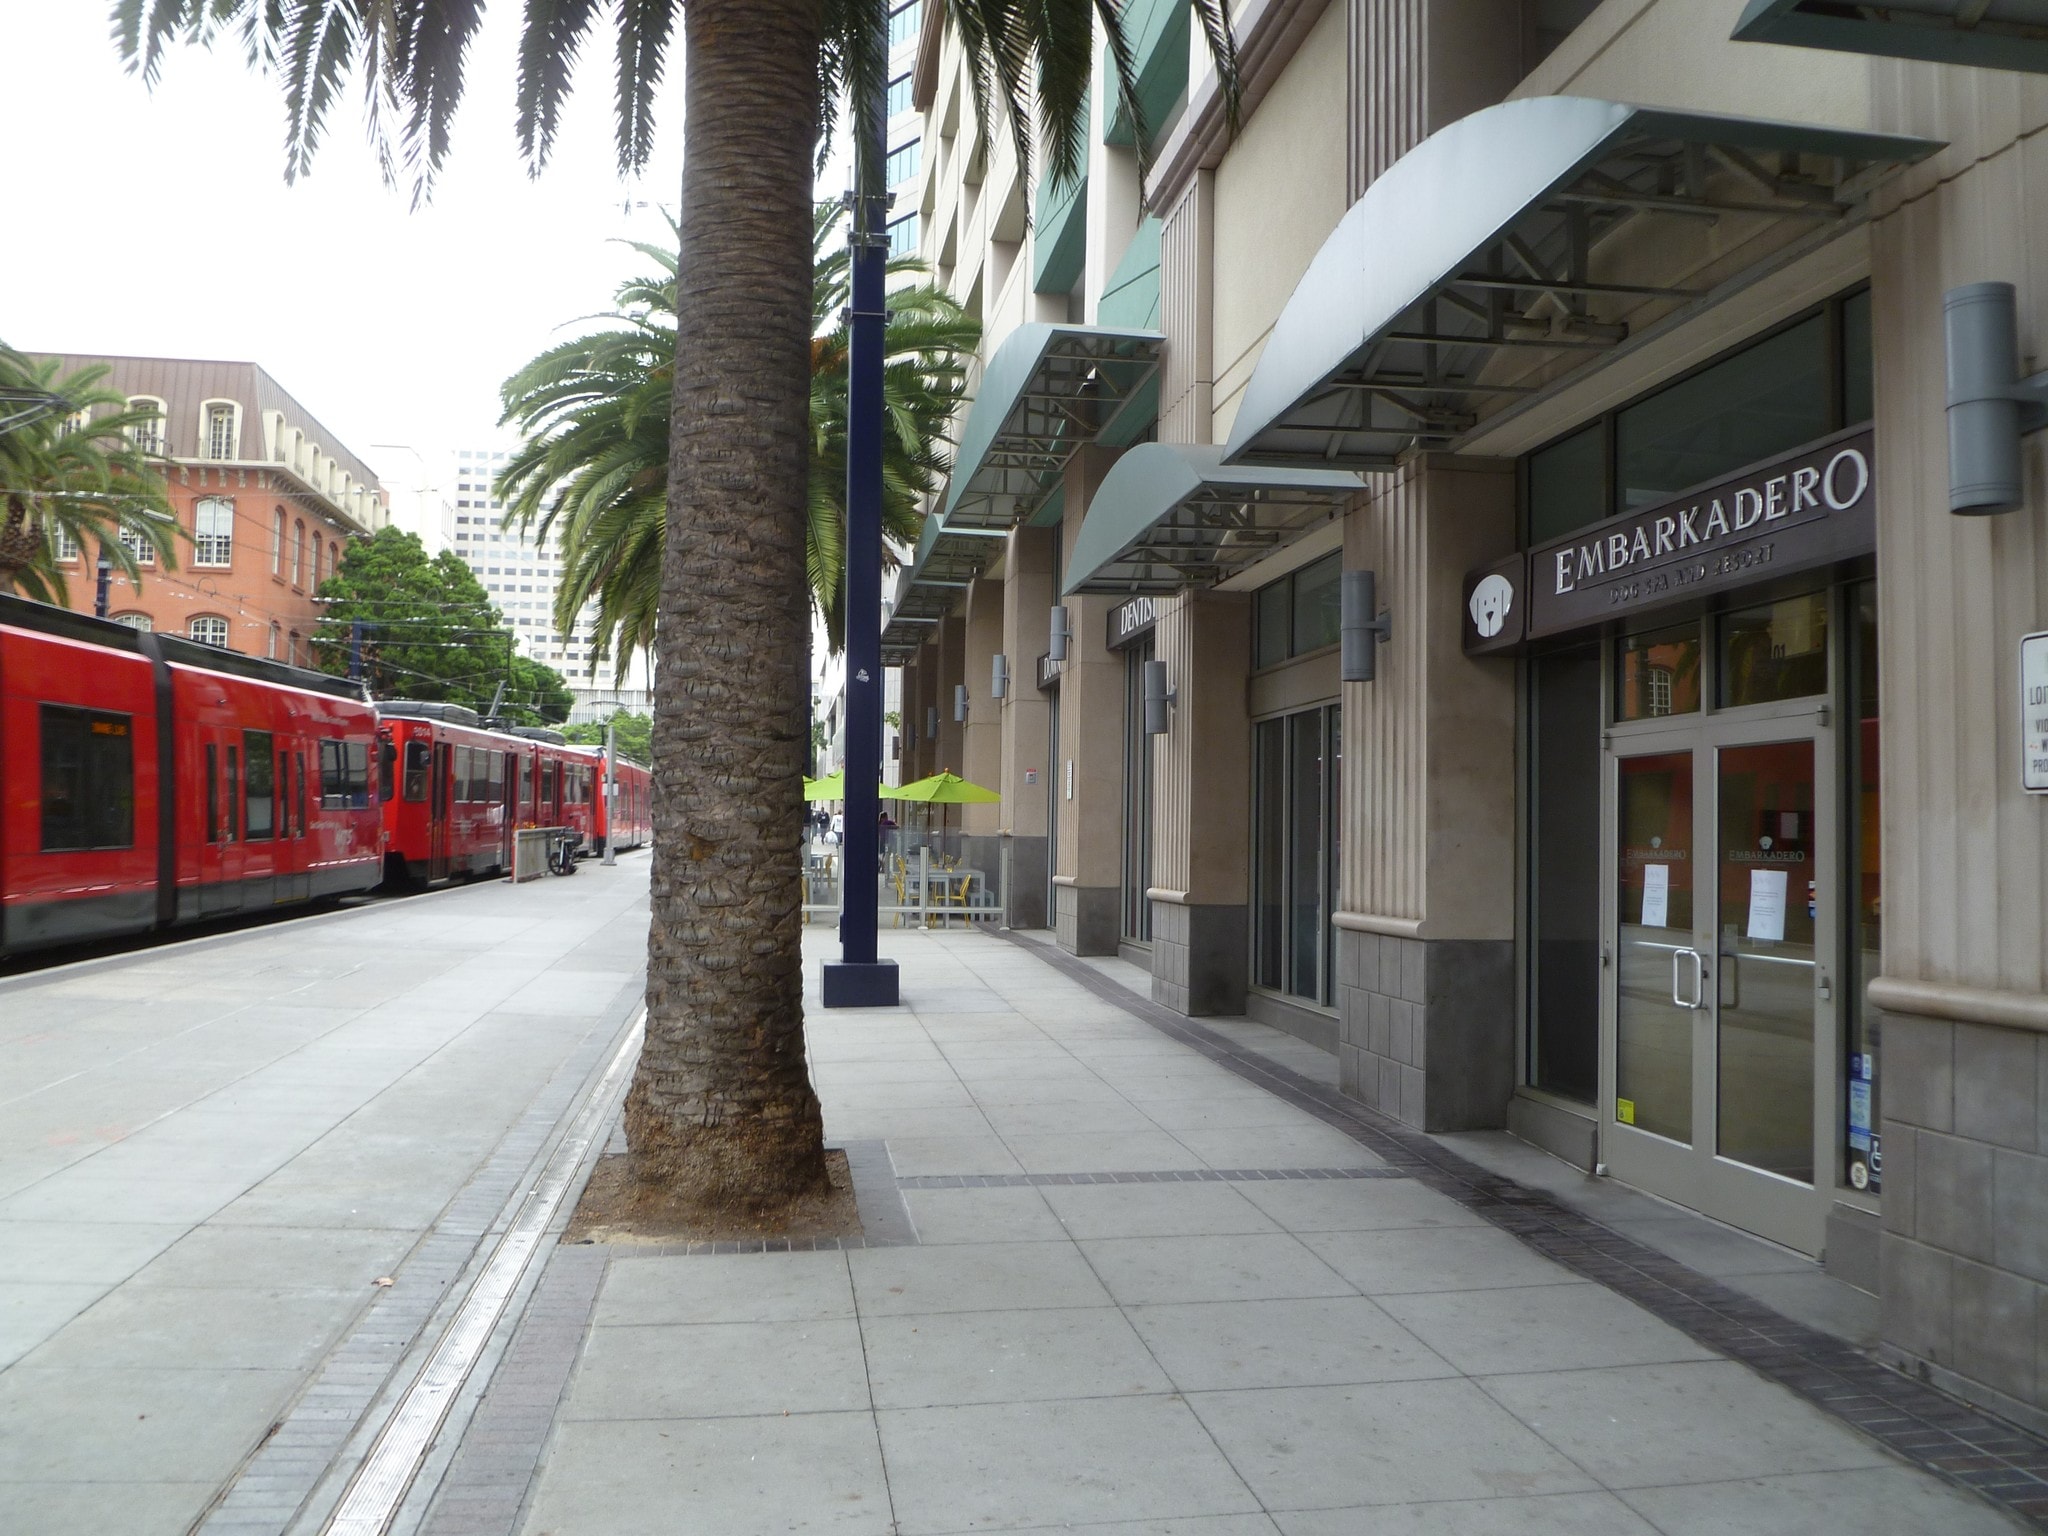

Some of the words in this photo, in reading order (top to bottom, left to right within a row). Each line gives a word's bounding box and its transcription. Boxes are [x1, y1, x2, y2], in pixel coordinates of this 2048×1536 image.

[1554, 448, 1869, 596] EMBARKADERO
[1674, 563, 1706, 587] AND
[1713, 543, 1775, 576] RESORT
[1728, 850, 1805, 862] EMBARKADERO
